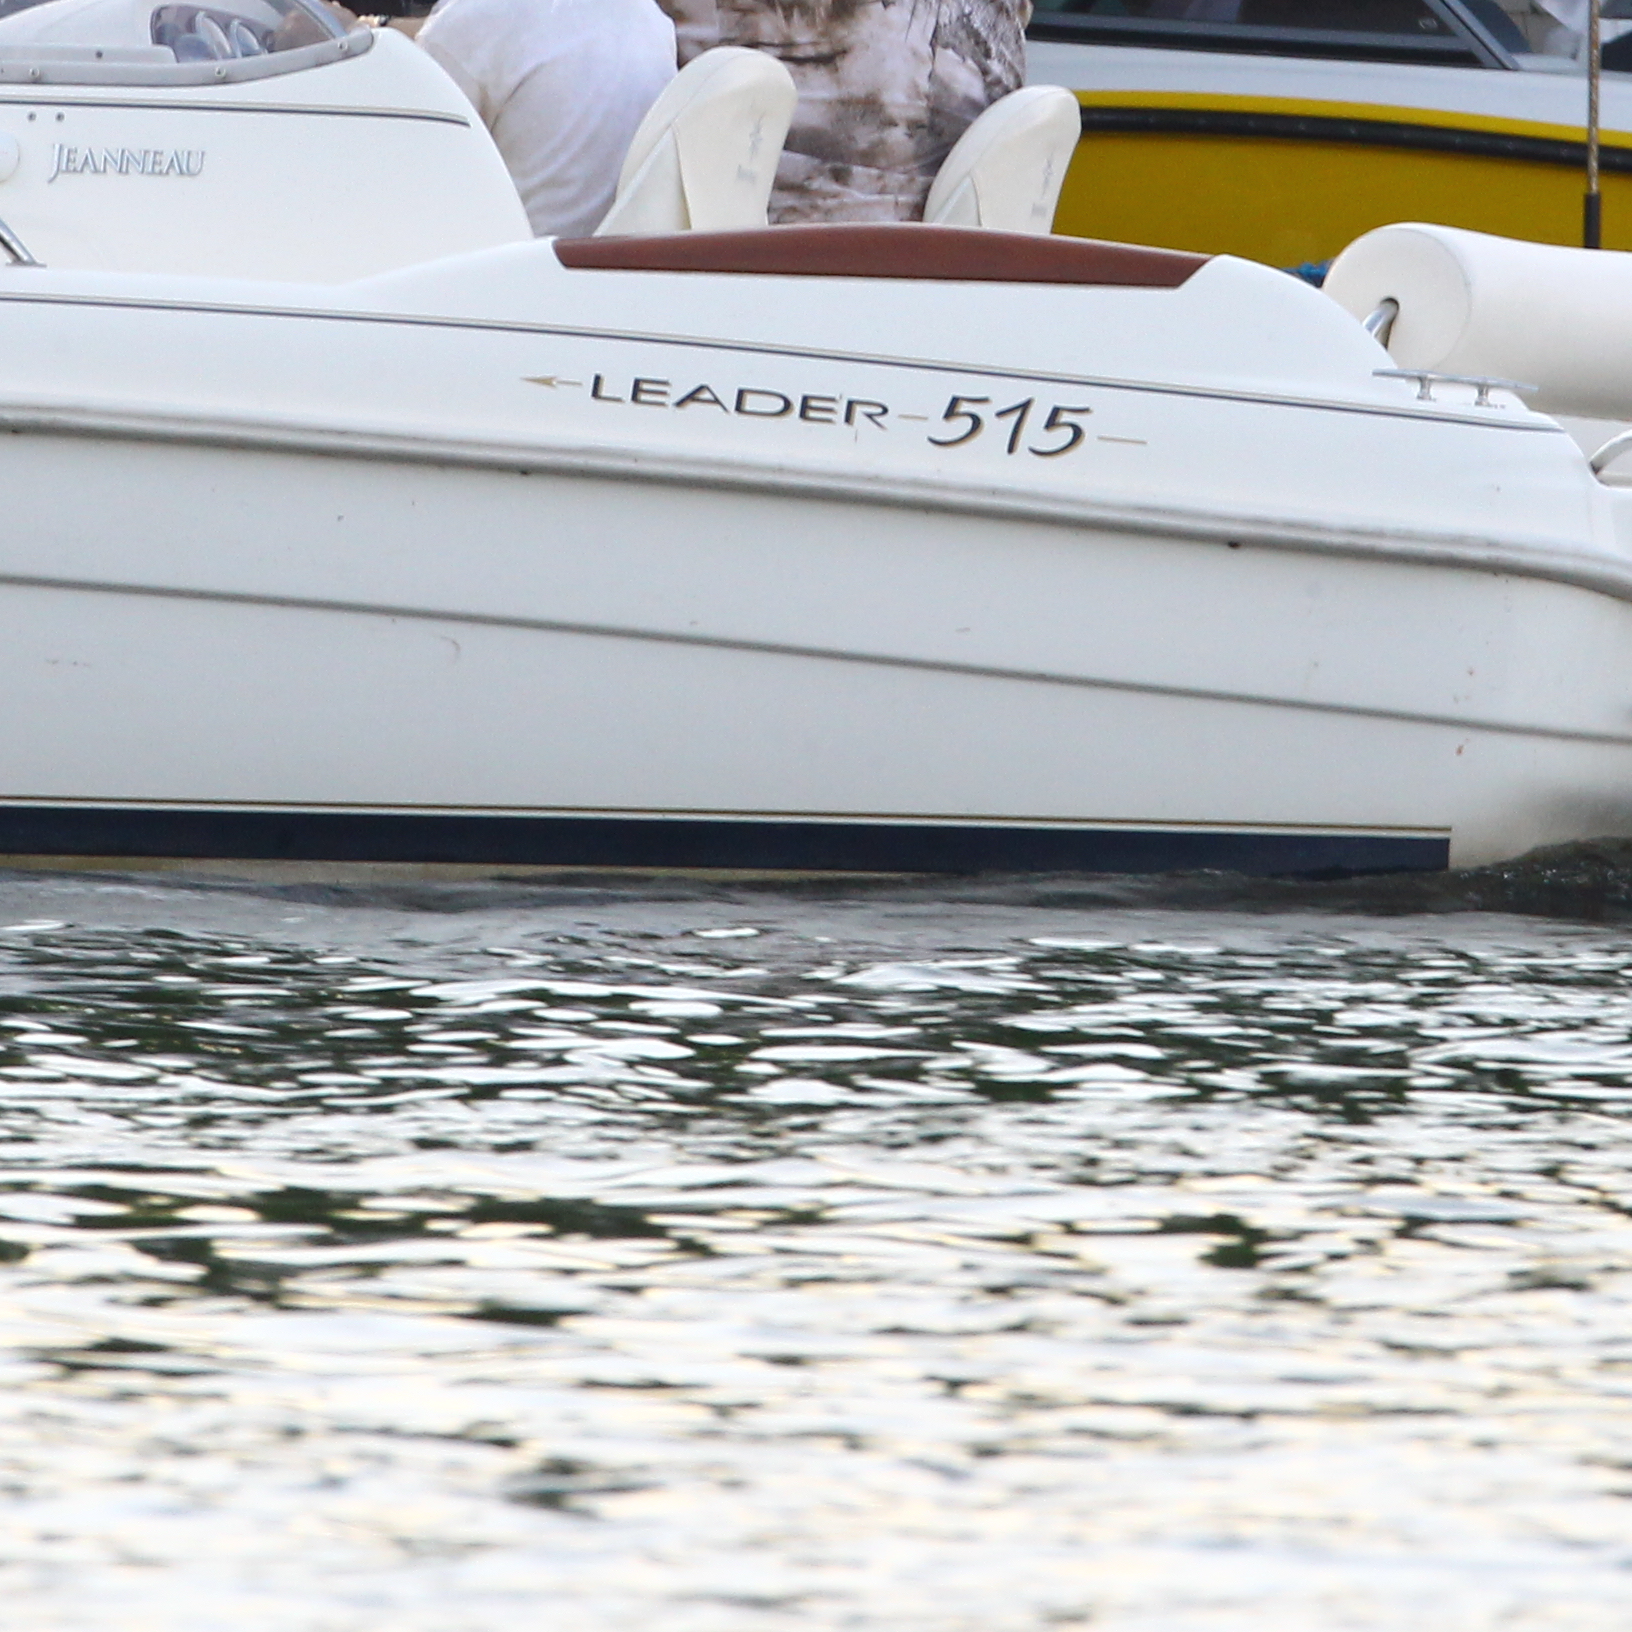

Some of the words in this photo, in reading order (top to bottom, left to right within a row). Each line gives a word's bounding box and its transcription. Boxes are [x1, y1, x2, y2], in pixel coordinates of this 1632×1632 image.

[48, 143, 206, 183] JEANNEAU
[590, 373, 889, 430] LEADER
[927, 394, 1093, 457] 515
